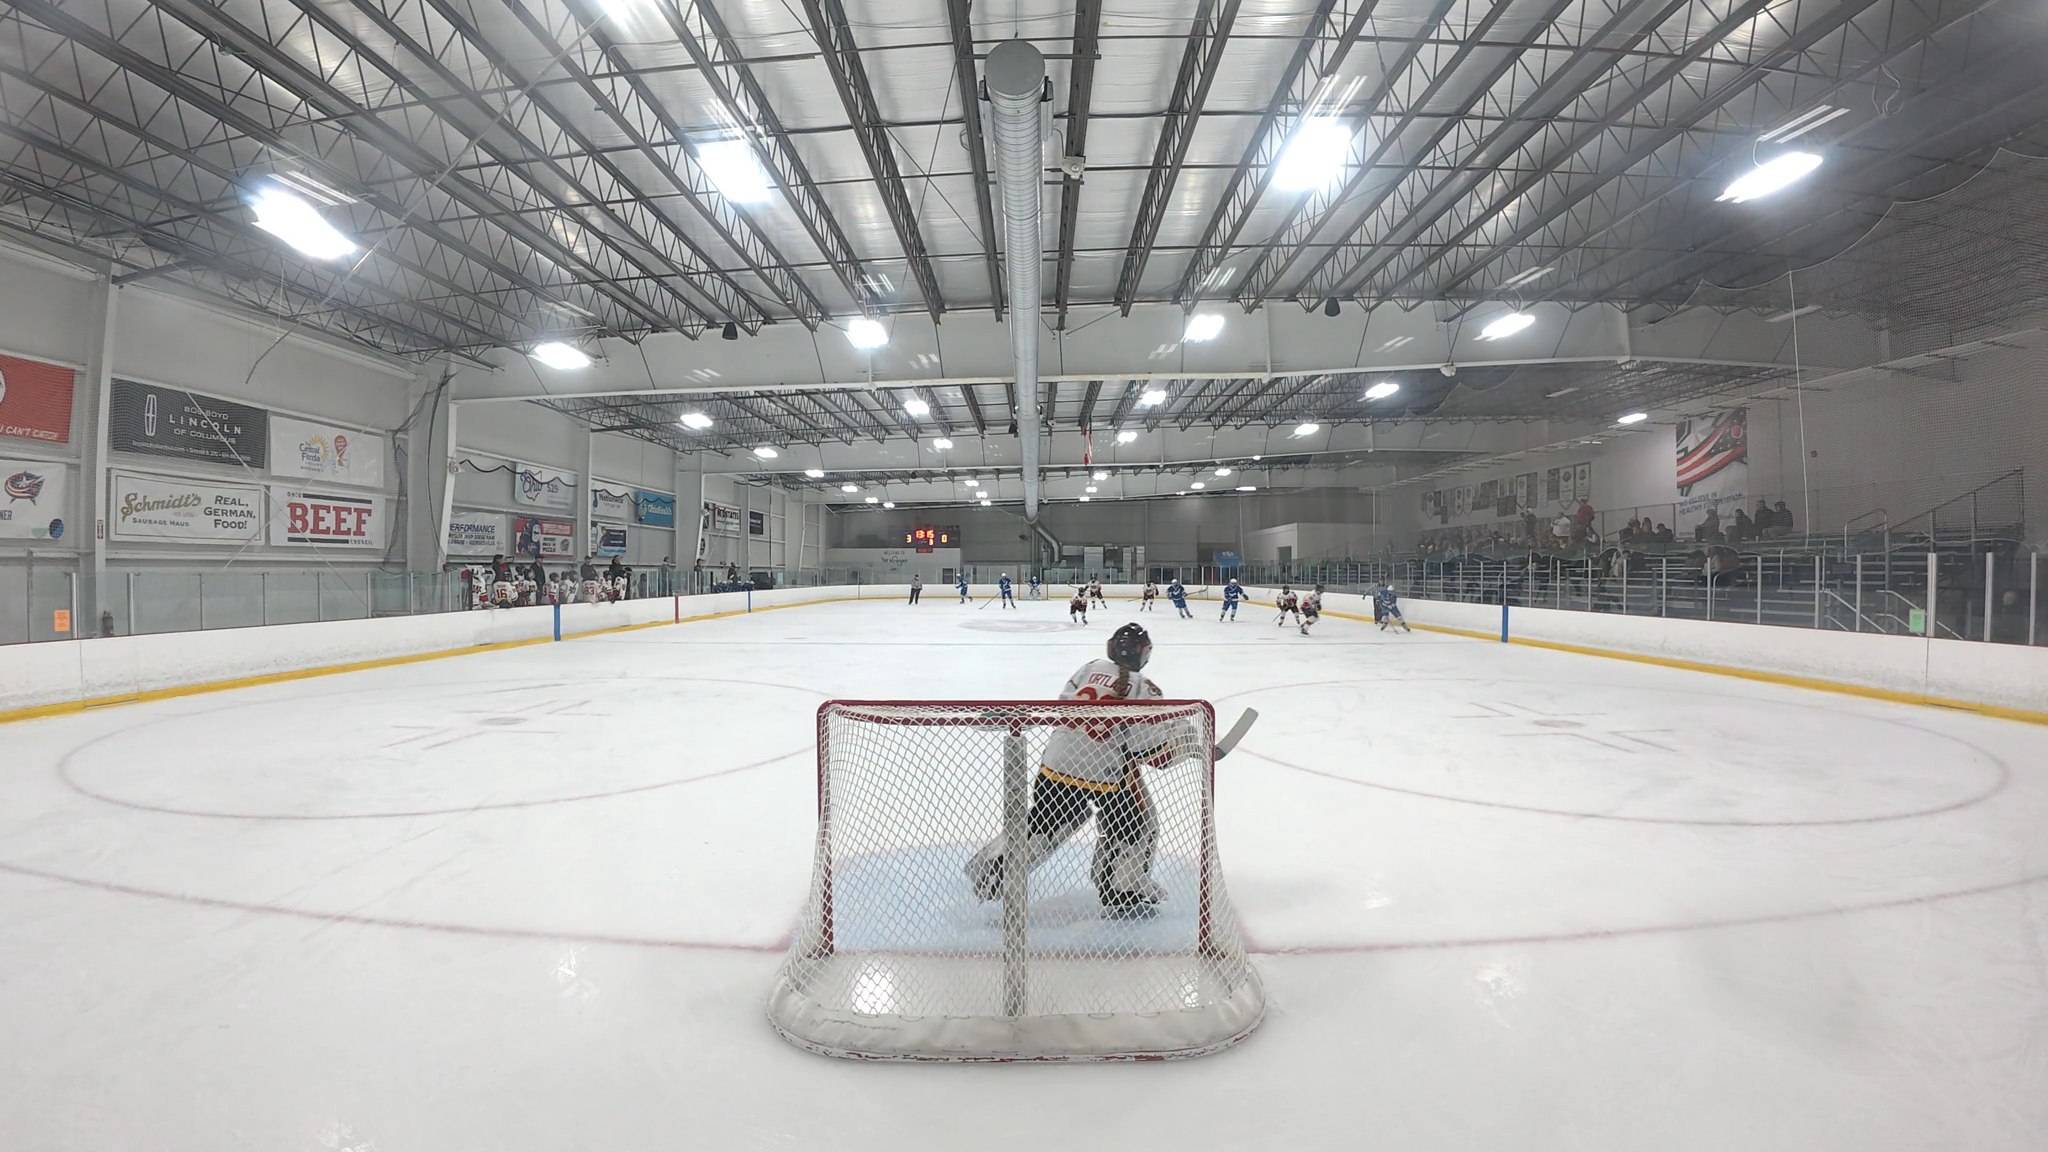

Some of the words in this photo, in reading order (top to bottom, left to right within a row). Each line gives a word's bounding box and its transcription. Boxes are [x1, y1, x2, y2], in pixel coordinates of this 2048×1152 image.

[169, 414, 242, 435] LINCOLN
[174, 428, 186, 436] OF
[121, 492, 202, 523] Schmidt's
[214, 495, 249, 507] REAL,
[203, 507, 256, 519] GERMAN,
[132, 517, 168, 526] SAUSAGE
[213, 519, 247, 530] FOOD!
[287, 501, 373, 537] BEEF
[449, 522, 495, 533] ERFORMANCE
[906, 534, 912, 543] 3
[941, 534, 948, 543] 0
[1088, 673, 1133, 697] ORTLAD
